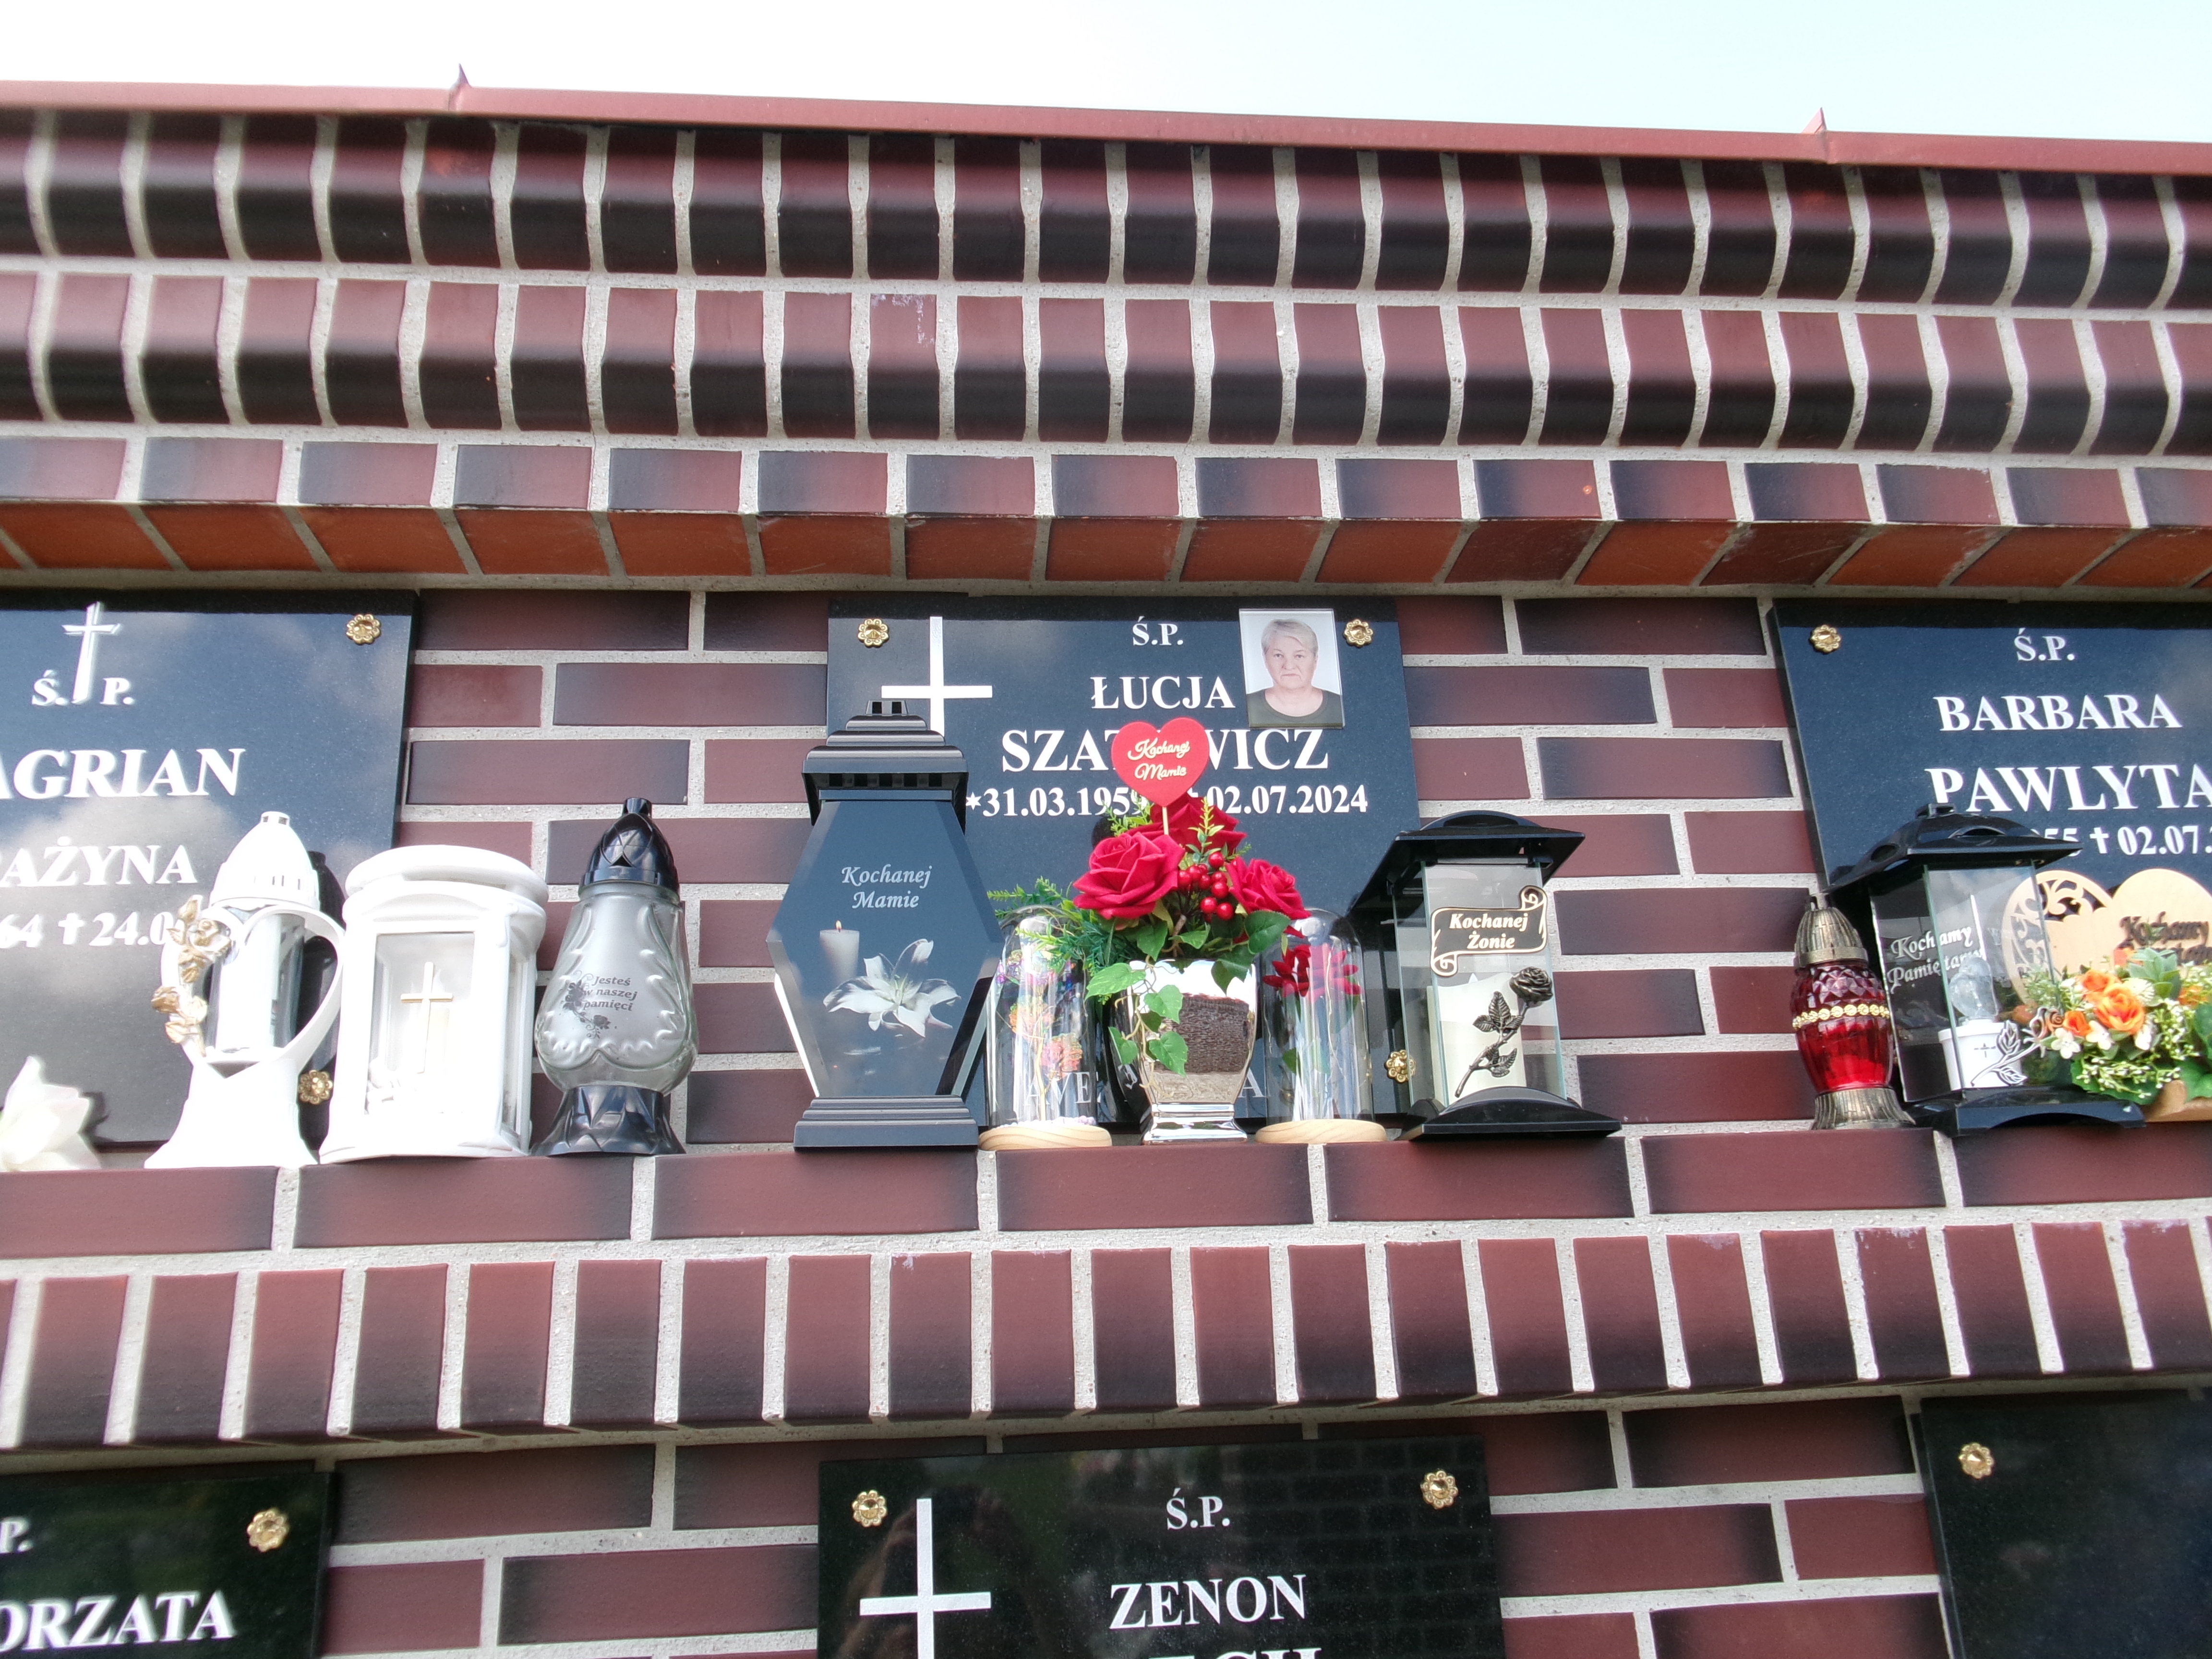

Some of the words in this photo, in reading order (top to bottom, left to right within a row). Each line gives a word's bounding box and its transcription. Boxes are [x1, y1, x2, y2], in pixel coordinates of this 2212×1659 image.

[1132, 615, 1184, 646] Ś.P.
[2015, 628, 2075, 661] Ś.P.
[32, 670, 69, 706] Ś.
[100, 677, 135, 706] P.
[1091, 675, 1236, 709] ŁUCJA
[1933, 694, 2183, 731] BARBARA
[0, 748, 247, 800] GRIAN
[1134, 763, 1187, 781] Mamie
[1206, 784, 1368, 814] 02.07.2024
[2117, 825, 2212, 855] 02.07.
[842, 864, 932, 889] Kochanej
[852, 890, 919, 909] Mamie
[1449, 913, 1528, 932] Kochanej
[1467, 930, 1515, 949] Żonie
[1890, 926, 1973, 960] Kochamy
[591, 976, 631, 986] Jesteś
[596, 989, 638, 1001] naszej
[583, 999, 633, 1011] pamięci
[1166, 1488, 1230, 1530] Ś.P.
[1109, 1575, 1307, 1630] ZENON
